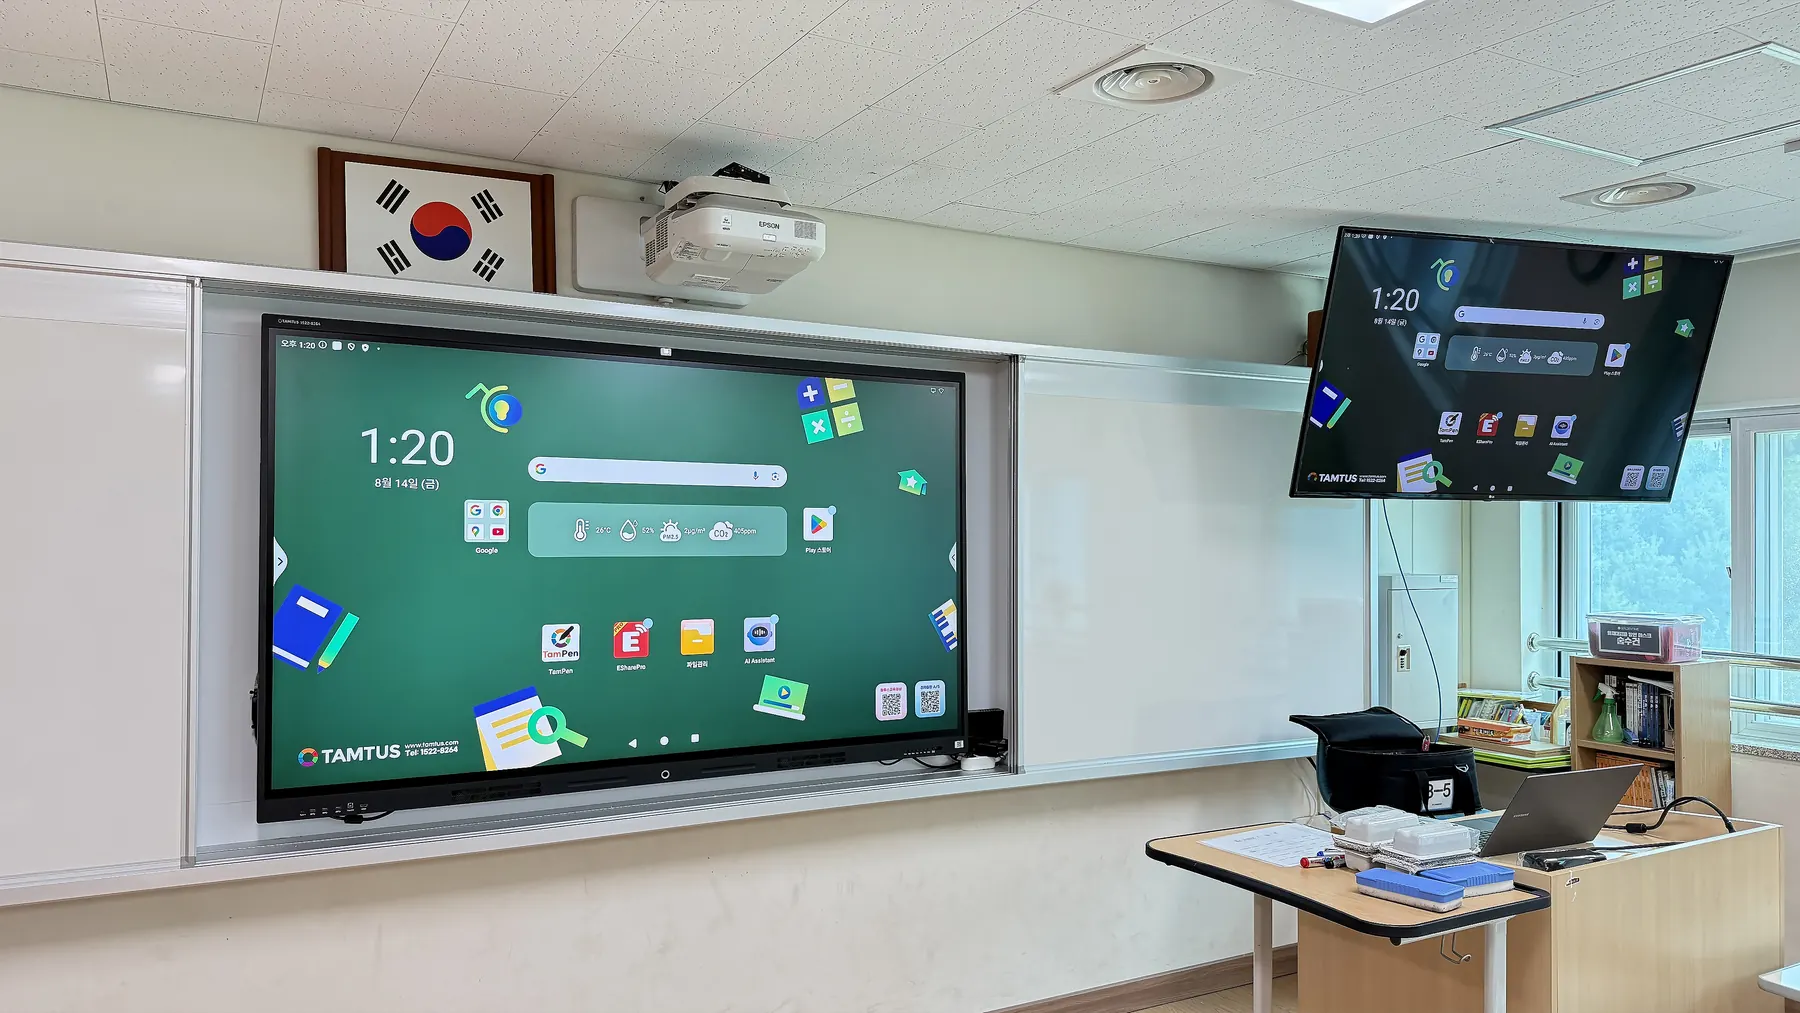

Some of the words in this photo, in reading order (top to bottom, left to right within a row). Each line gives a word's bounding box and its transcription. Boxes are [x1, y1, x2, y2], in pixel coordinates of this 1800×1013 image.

[758, 220, 780, 230] EPSON
[1372, 286, 1420, 312] 1:20
[281, 339, 297, 347] 오후
[299, 341, 316, 349] 1:20
[361, 427, 455, 466] 1:20
[1318, 473, 1358, 483] TAMTUS
[374, 477, 392, 489] 8월
[395, 477, 418, 490] 14일
[421, 478, 440, 491] (금)
[475, 546, 499, 554] Google
[614, 622, 624, 633] PRO
[543, 649, 579, 658] TamPen
[616, 663, 646, 672] ESharePro
[404, 740, 459, 749] www.tamtus.com
[321, 744, 401, 764] TAMTUS
[420, 746, 459, 756] 1522-8264
